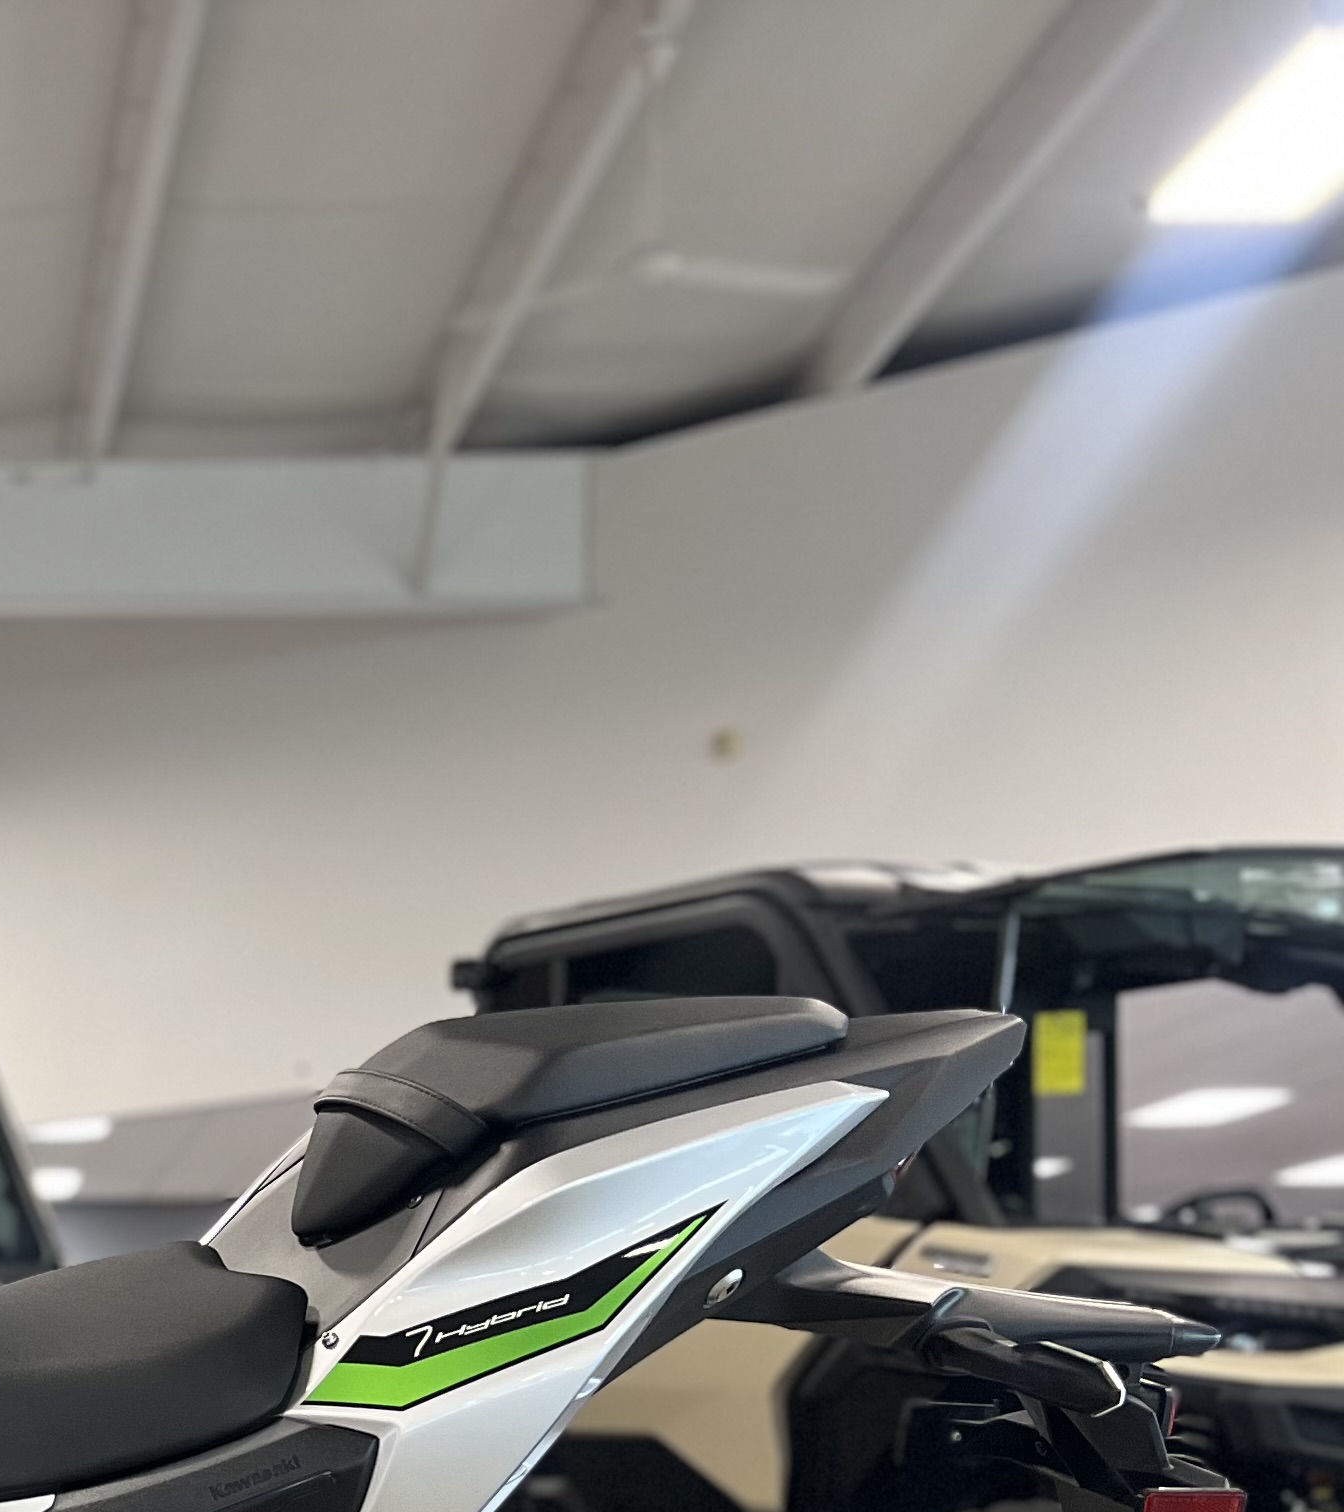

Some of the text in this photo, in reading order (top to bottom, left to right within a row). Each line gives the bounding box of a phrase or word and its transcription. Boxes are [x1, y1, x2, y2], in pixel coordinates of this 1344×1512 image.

[406, 1292, 571, 1358] 7 Hybrid
[207, 1453, 303, 1502] Kawasaki
